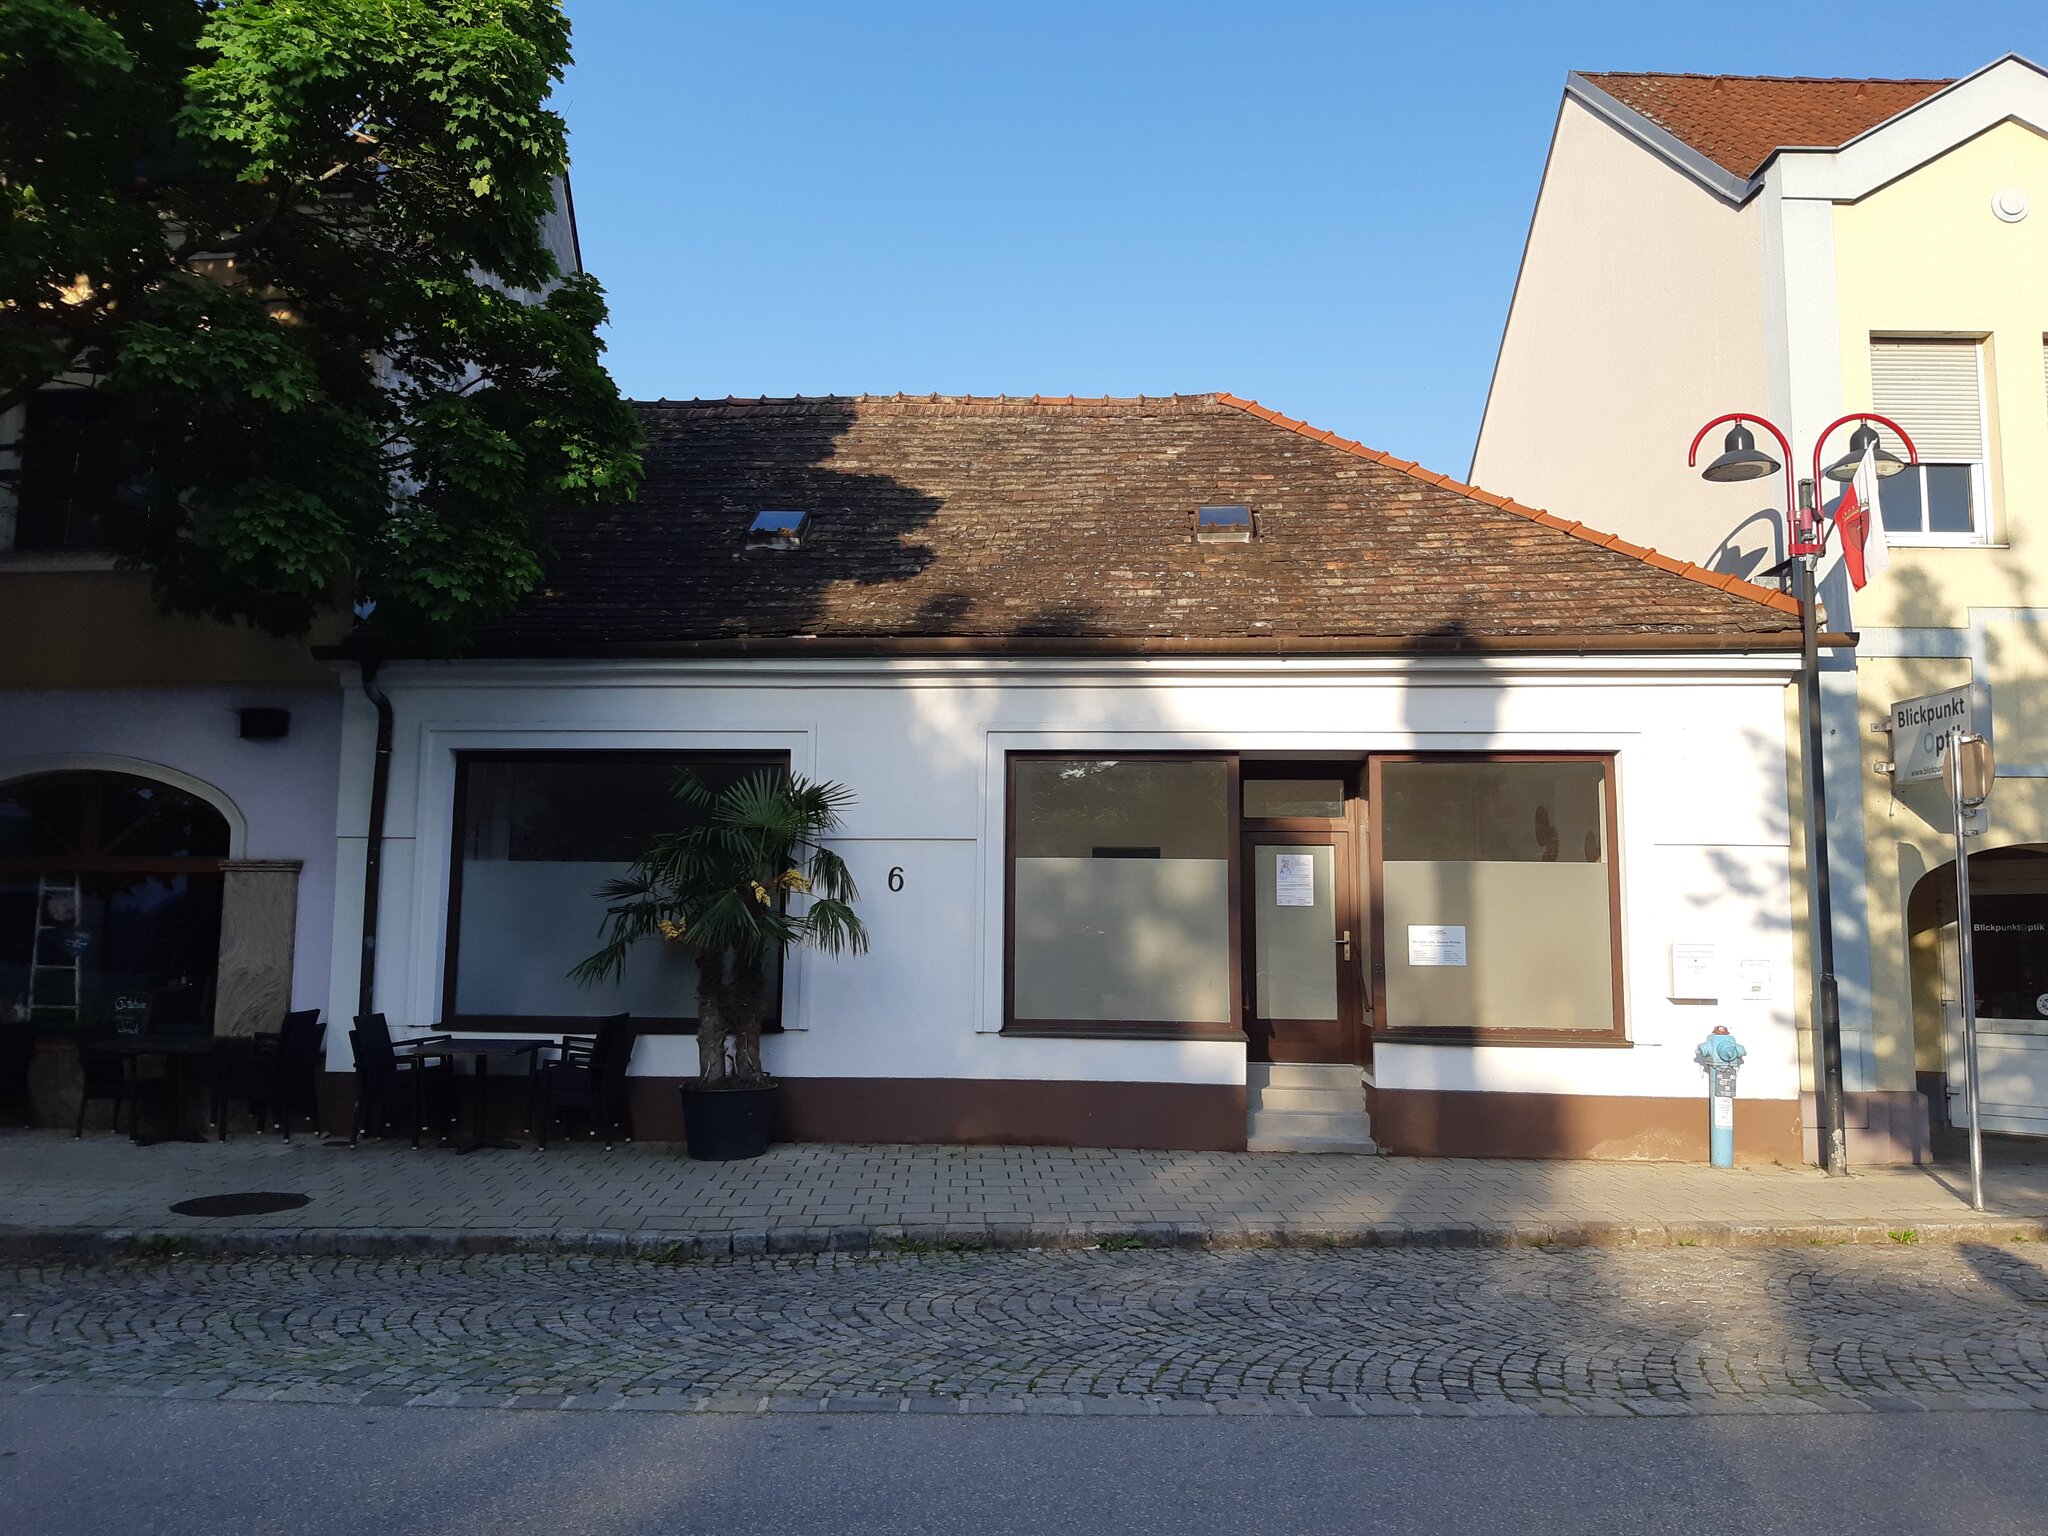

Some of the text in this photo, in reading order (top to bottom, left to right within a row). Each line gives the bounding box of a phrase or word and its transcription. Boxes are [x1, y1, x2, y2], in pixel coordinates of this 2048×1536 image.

[1897, 697, 1965, 728] Blickpunkt
[1923, 724, 1965, 757] Opt
[888, 866, 904, 892] 6
